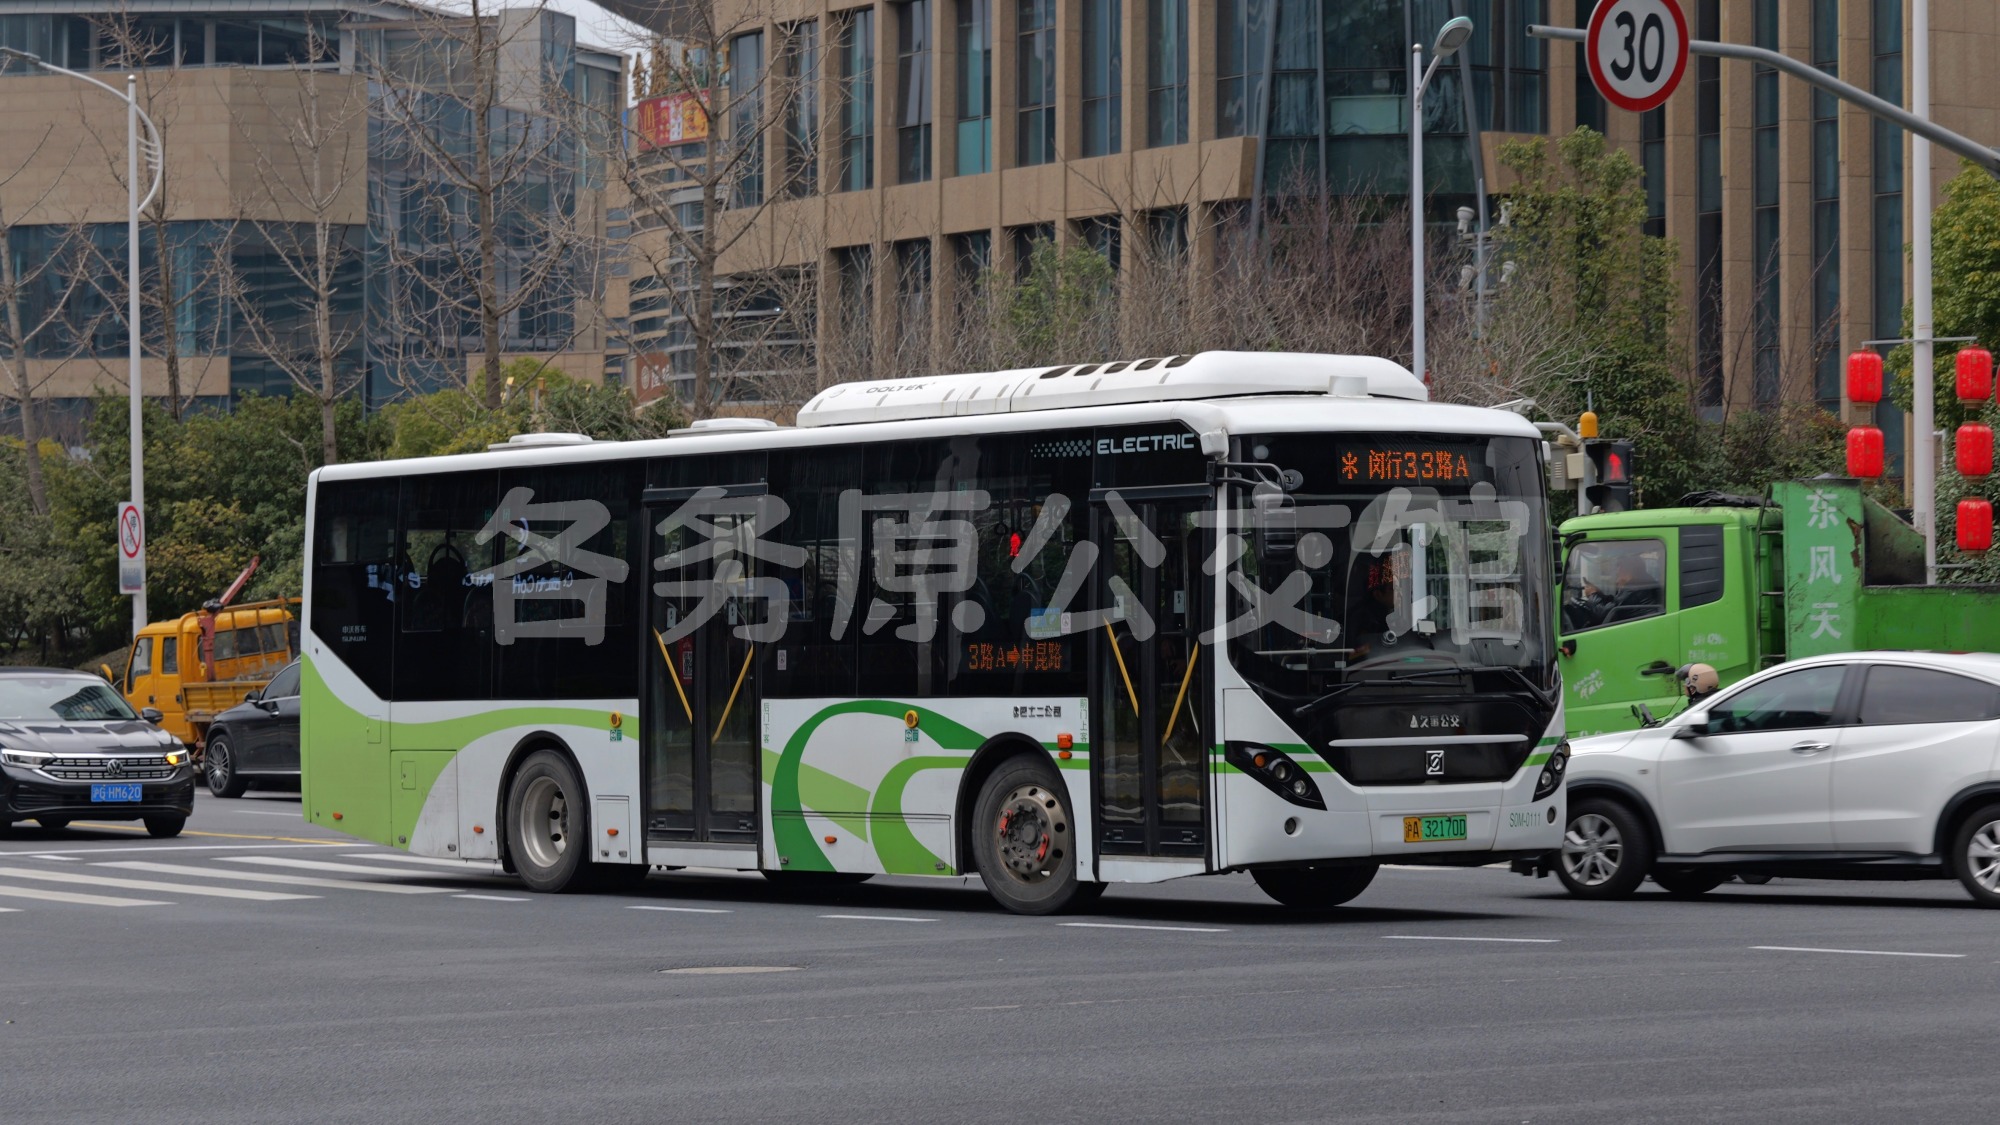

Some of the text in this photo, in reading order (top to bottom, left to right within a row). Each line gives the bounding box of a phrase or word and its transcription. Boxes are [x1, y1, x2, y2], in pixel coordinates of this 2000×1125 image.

[1610, 11, 1664, 83] 30
[1097, 433, 1194, 454] ELECTRIC
[1368, 449, 1469, 480] 闵行33路A
[1806, 488, 1842, 640] 东风天
